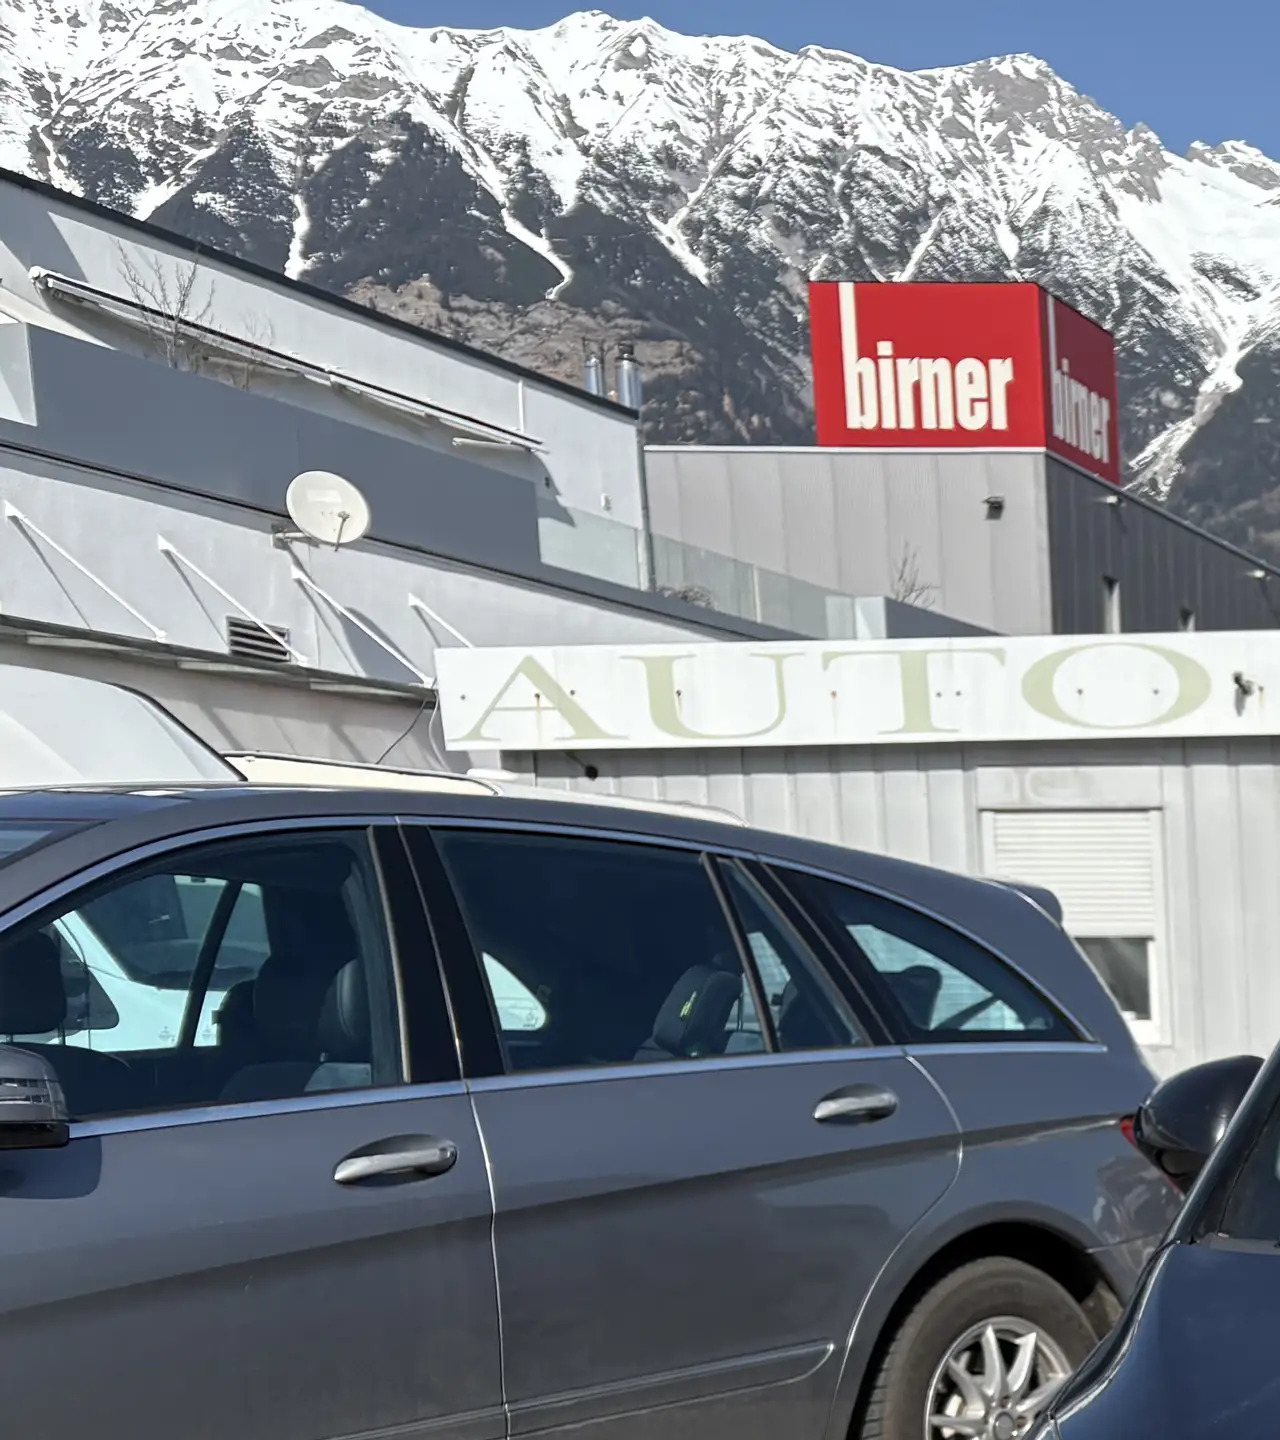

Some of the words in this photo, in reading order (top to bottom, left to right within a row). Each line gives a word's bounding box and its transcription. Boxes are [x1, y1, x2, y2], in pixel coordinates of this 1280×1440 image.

[838, 282, 1014, 431] birner
[1047, 294, 1111, 463] birner
[447, 642, 1213, 742] AUTO
